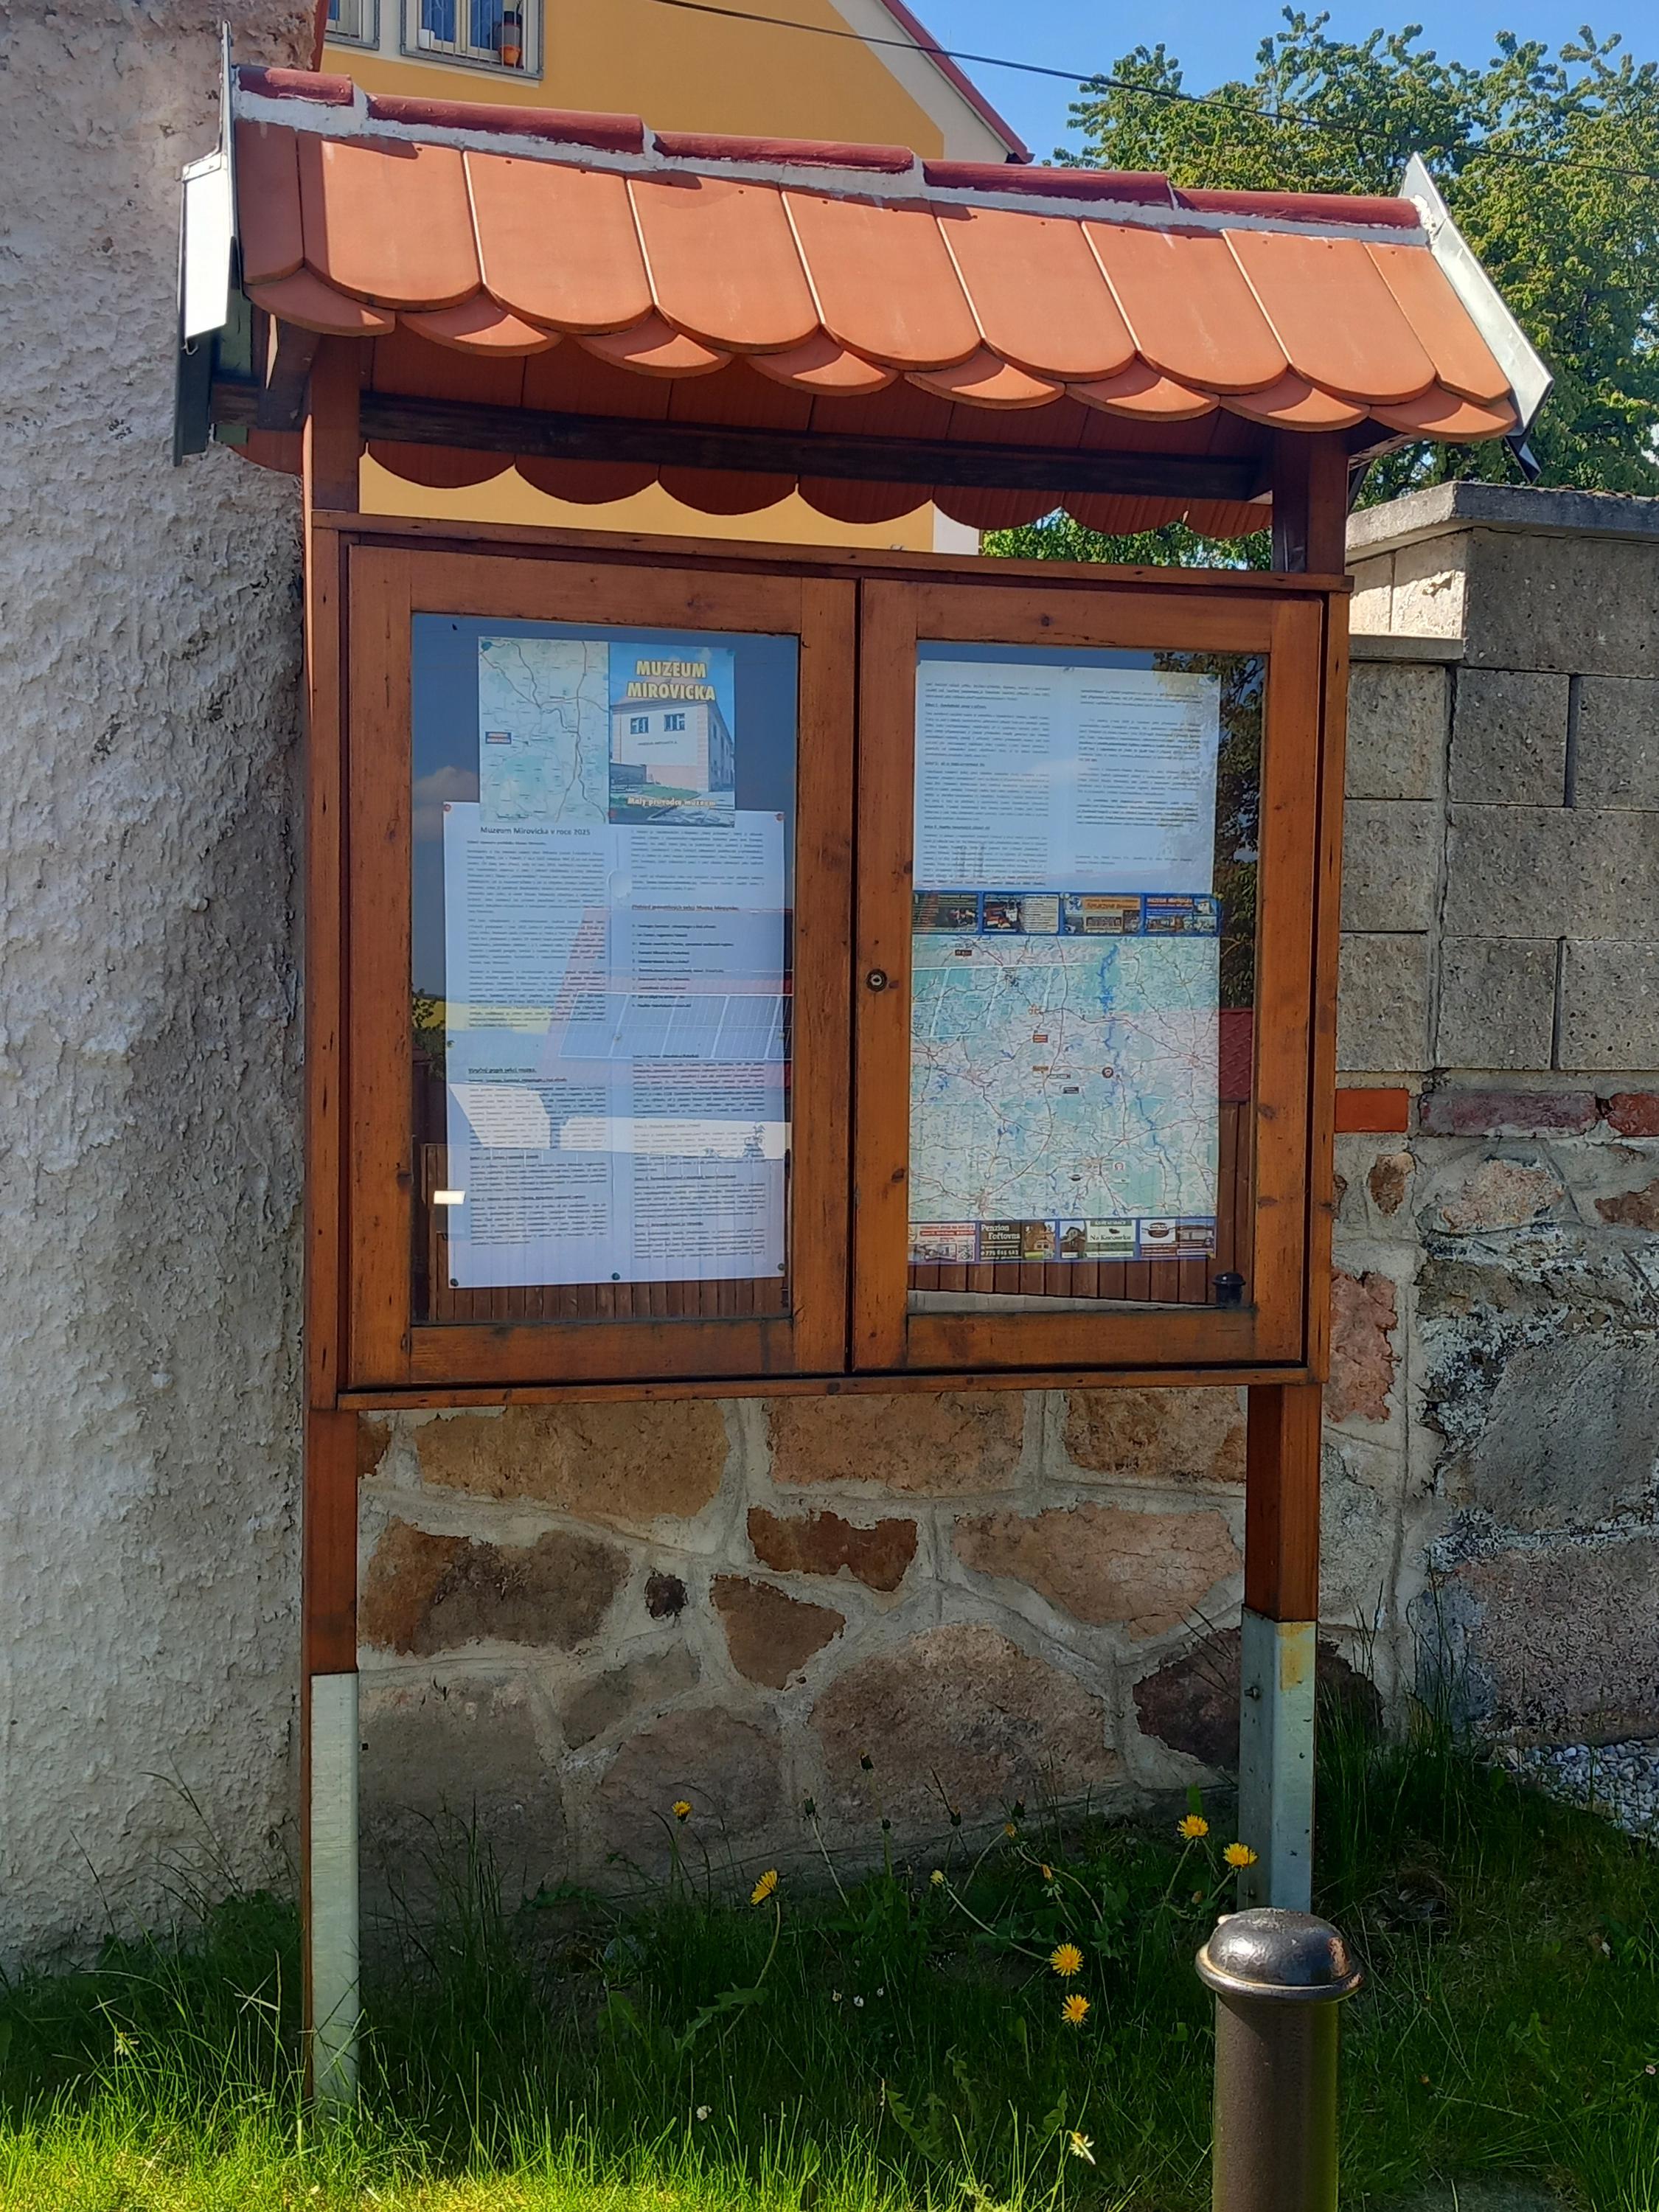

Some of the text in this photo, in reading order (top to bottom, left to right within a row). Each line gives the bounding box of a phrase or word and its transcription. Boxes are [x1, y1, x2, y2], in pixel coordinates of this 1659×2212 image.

[636, 660, 706, 678] MUZEUM
[627, 681, 716, 701] MIROVICKA
[480, 826, 512, 835] Muzeum
[513, 826, 549, 835] Mirovicka
